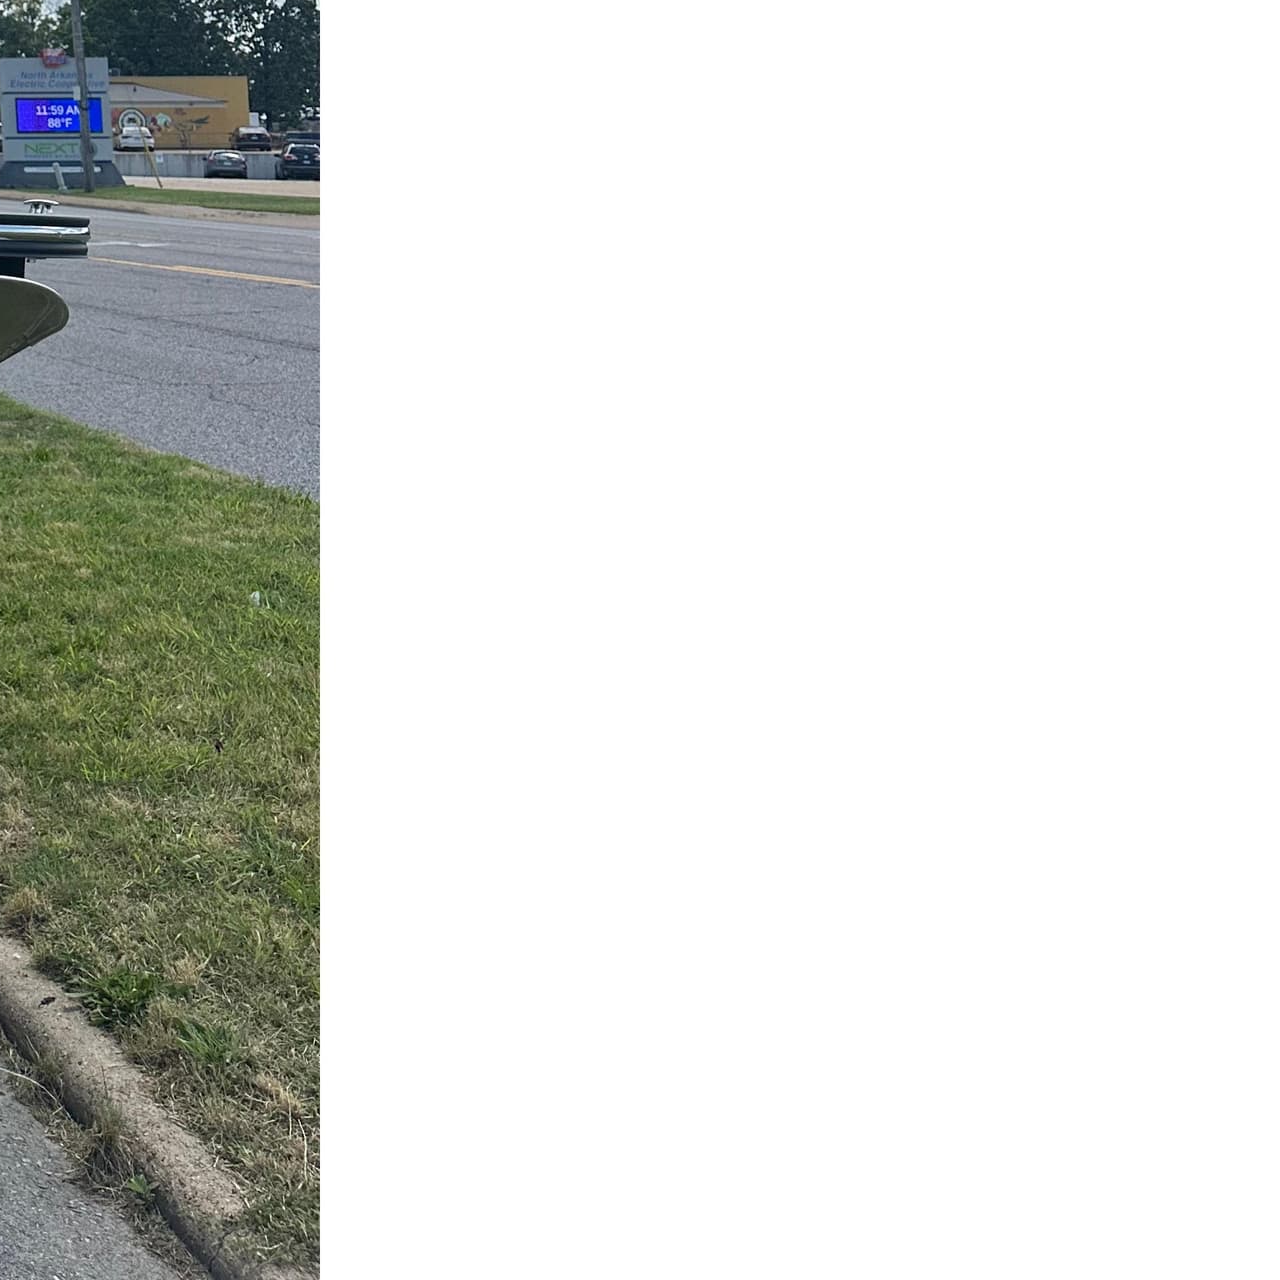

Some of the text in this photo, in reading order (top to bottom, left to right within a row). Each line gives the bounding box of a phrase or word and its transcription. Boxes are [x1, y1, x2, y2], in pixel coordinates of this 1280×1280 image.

[20, 71, 47, 80] North
[9, 80, 44, 89] Electric
[35, 105, 65, 116] 11:59
[47, 117, 73, 128] 88°F
[24, 142, 80, 154] NEXT
